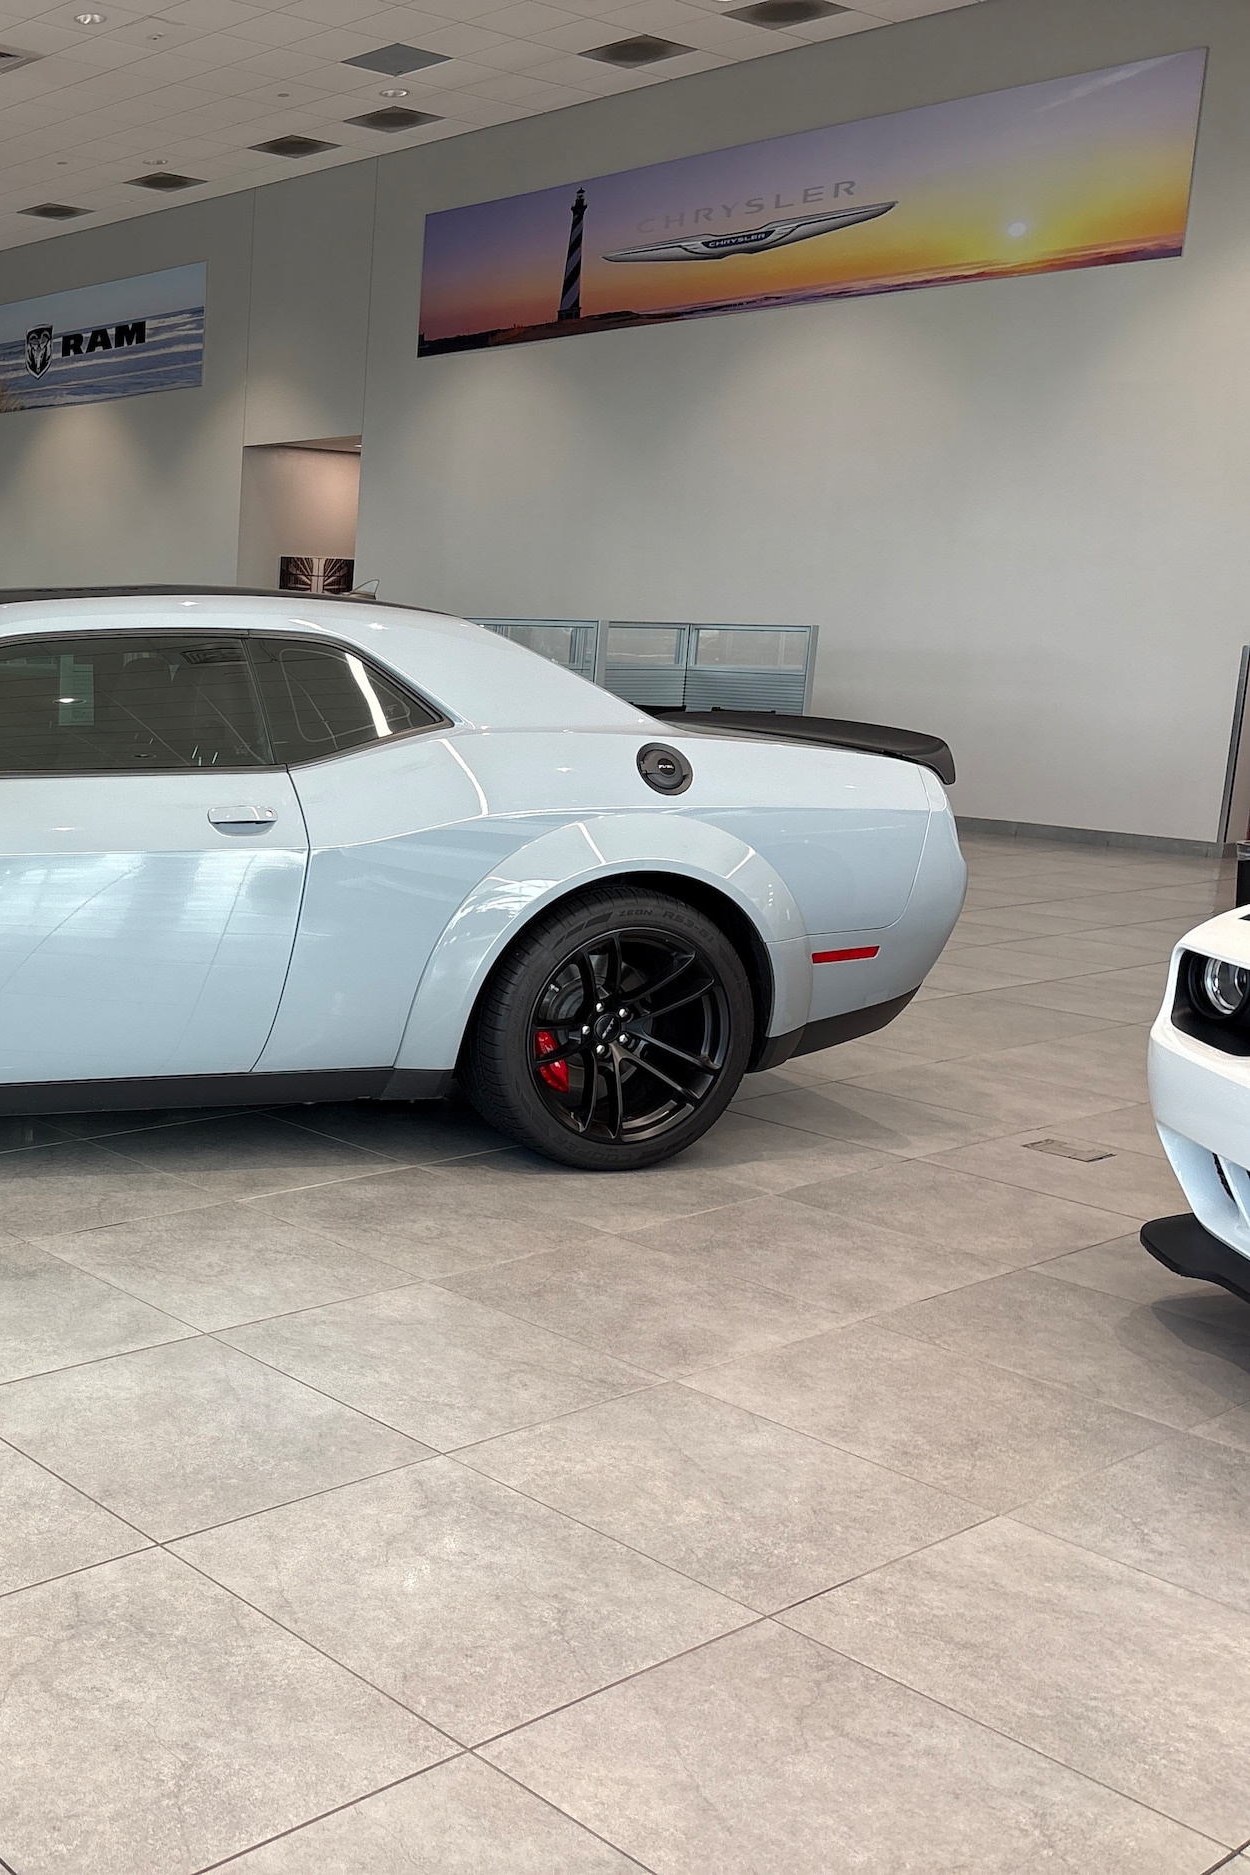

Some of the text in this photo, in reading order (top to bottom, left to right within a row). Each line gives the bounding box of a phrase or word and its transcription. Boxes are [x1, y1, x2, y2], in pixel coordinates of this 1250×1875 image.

[637, 180, 856, 234] CHRYSLER
[708, 232, 766, 247] CHRYSLER
[61, 320, 147, 358] RAM
[618, 909, 653, 918] ZEON
